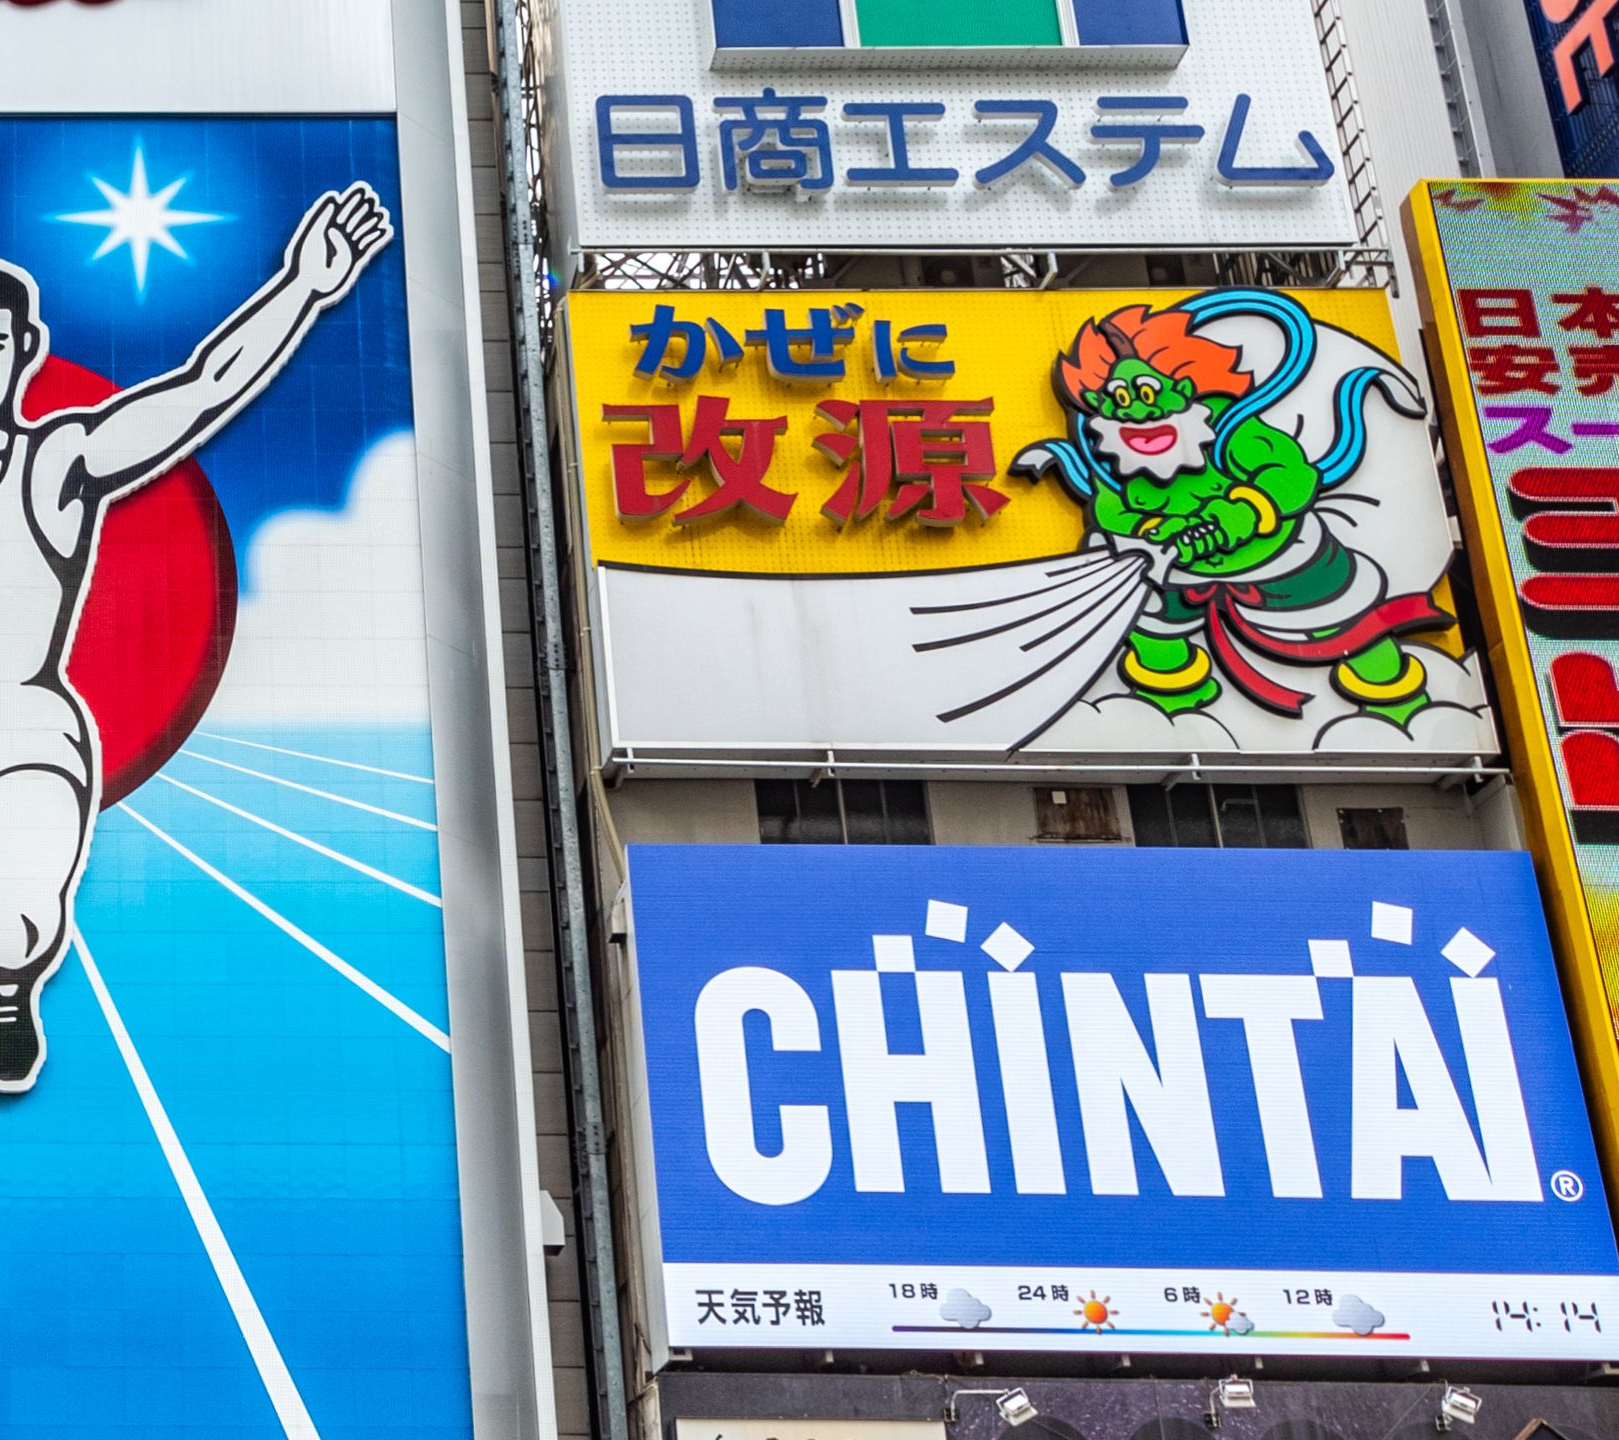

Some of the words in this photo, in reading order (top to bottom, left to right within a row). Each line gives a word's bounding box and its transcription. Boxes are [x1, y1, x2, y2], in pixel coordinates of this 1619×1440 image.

[594, 88, 1336, 194] 日商エステム
[630, 302, 956, 384] かぜに
[602, 396, 1011, 530] 改源
[696, 1289, 826, 1327] 天気予報
[888, 1281, 940, 1301] 18時
[1018, 1283, 1070, 1303] 24時
[1163, 1285, 1202, 1305] 6時
[1283, 1287, 1334, 1308] 12時
